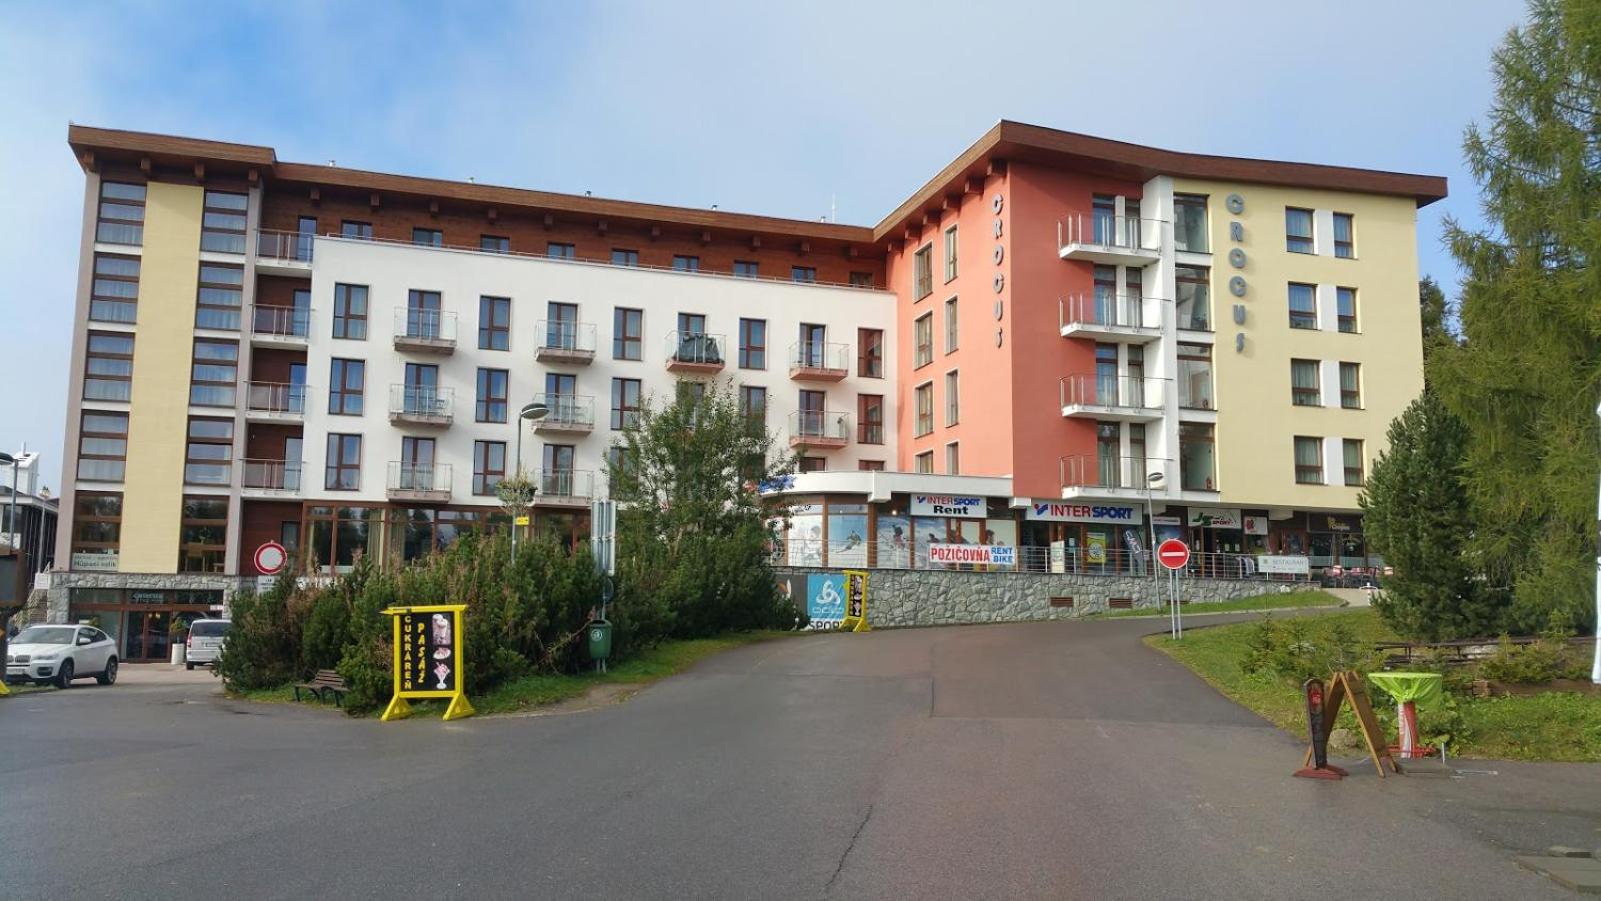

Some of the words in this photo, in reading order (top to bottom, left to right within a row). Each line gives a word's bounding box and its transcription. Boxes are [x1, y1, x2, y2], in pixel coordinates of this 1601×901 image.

[992, 193, 1004, 349] CROCUS
[1225, 193, 1247, 354] CROCUS
[927, 495, 980, 506] INTERSPORT
[933, 505, 968, 515] Rent
[1050, 503, 1133, 520] INTERSPORT
[991, 546, 1013, 555] RENT
[993, 555, 1013, 563] BIKE
